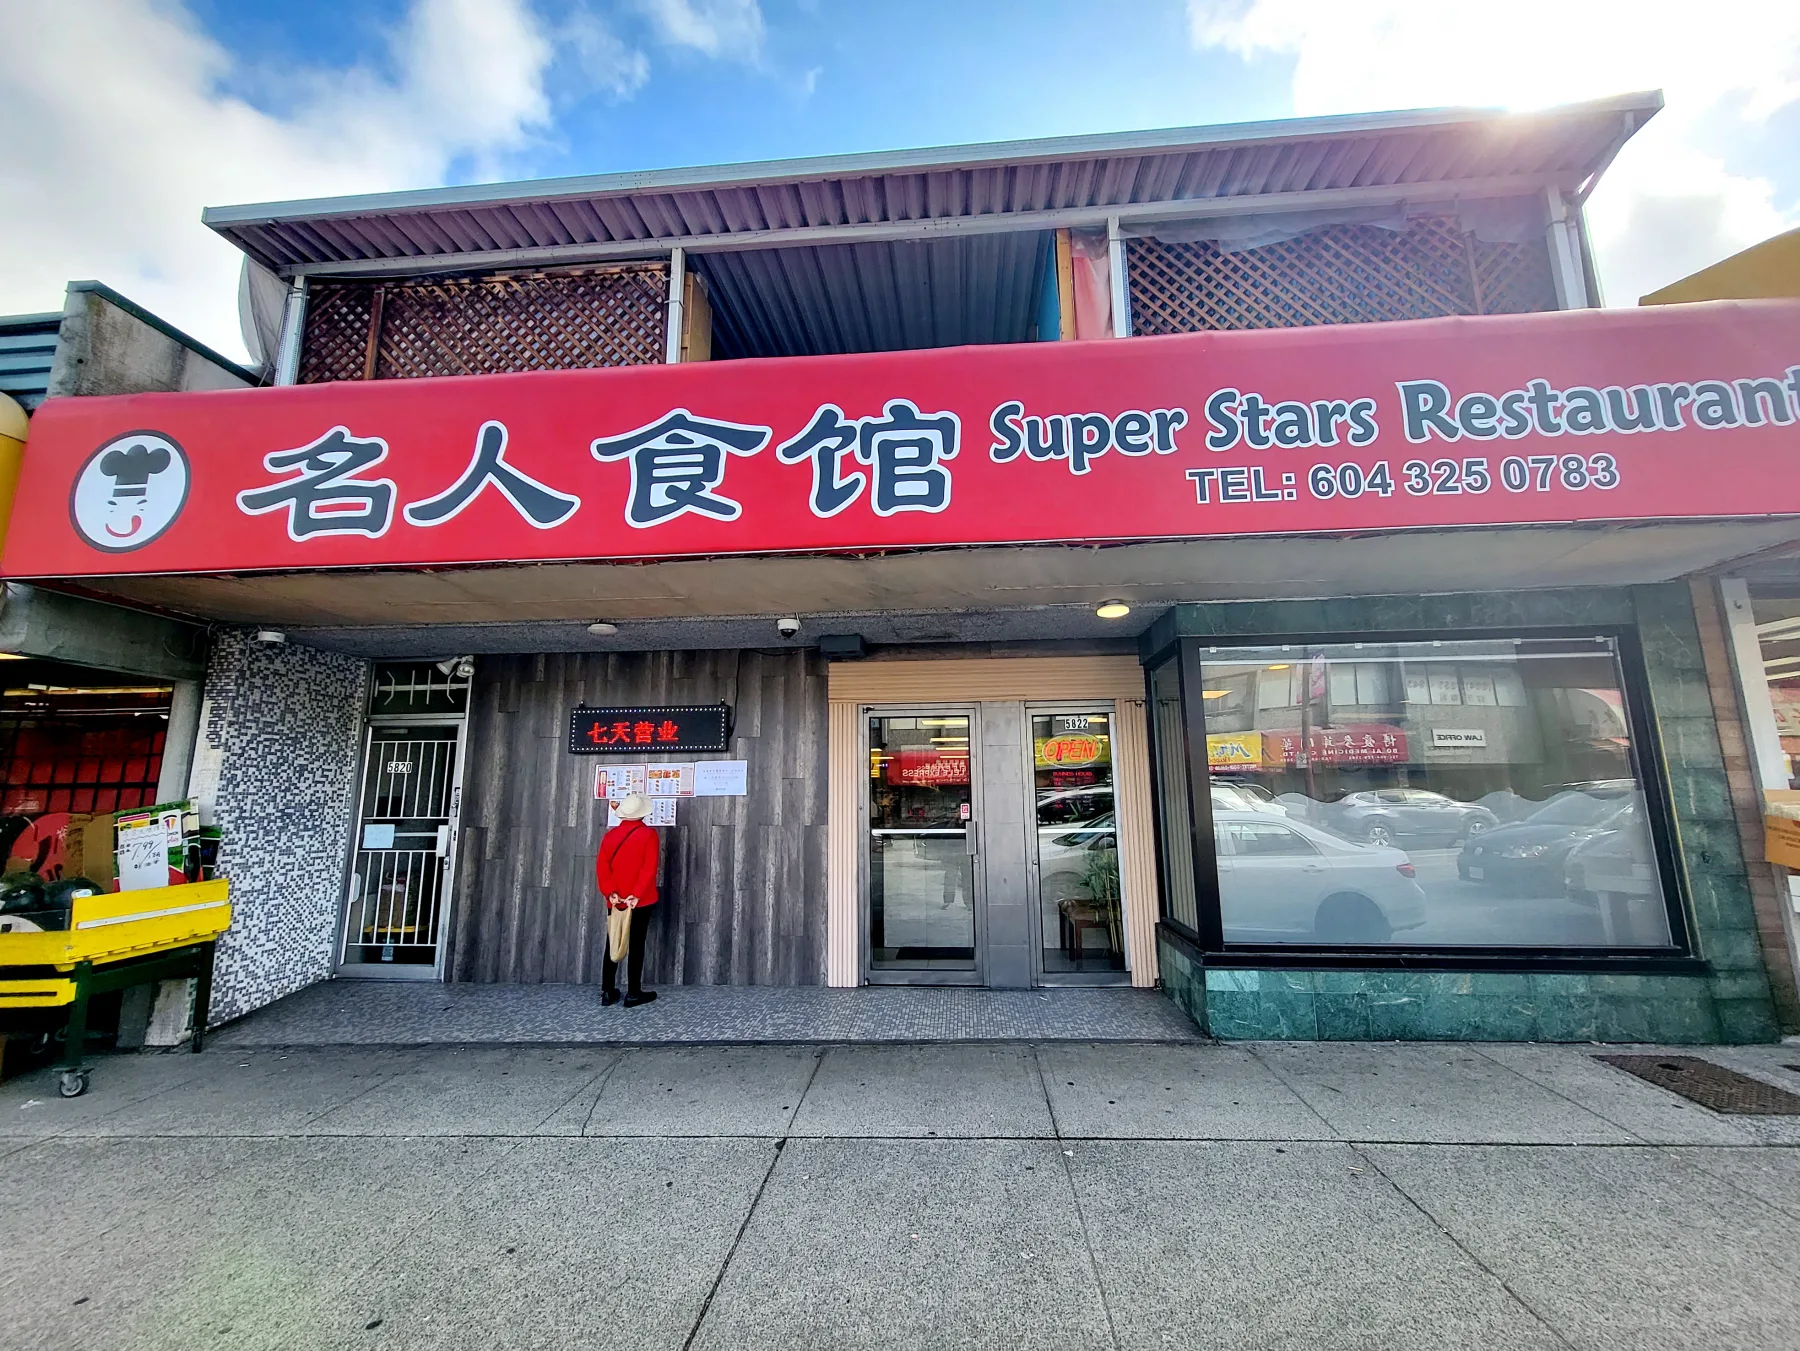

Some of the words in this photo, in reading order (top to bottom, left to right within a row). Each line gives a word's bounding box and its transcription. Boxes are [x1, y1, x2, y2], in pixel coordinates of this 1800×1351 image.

[989, 401, 1188, 475] Super
[1204, 388, 1379, 452] Stars
[236, 398, 961, 542] 名人食馆
[1185, 466, 1297, 504] TEL:
[1308, 461, 1395, 500] 604
[1402, 457, 1492, 496] 325
[1500, 453, 1620, 493] 0783
[587, 720, 679, 744] 七天营业
[1065, 718, 1088, 729] 5822
[1044, 740, 1096, 761] OPEN
[388, 762, 412, 773] 5820
